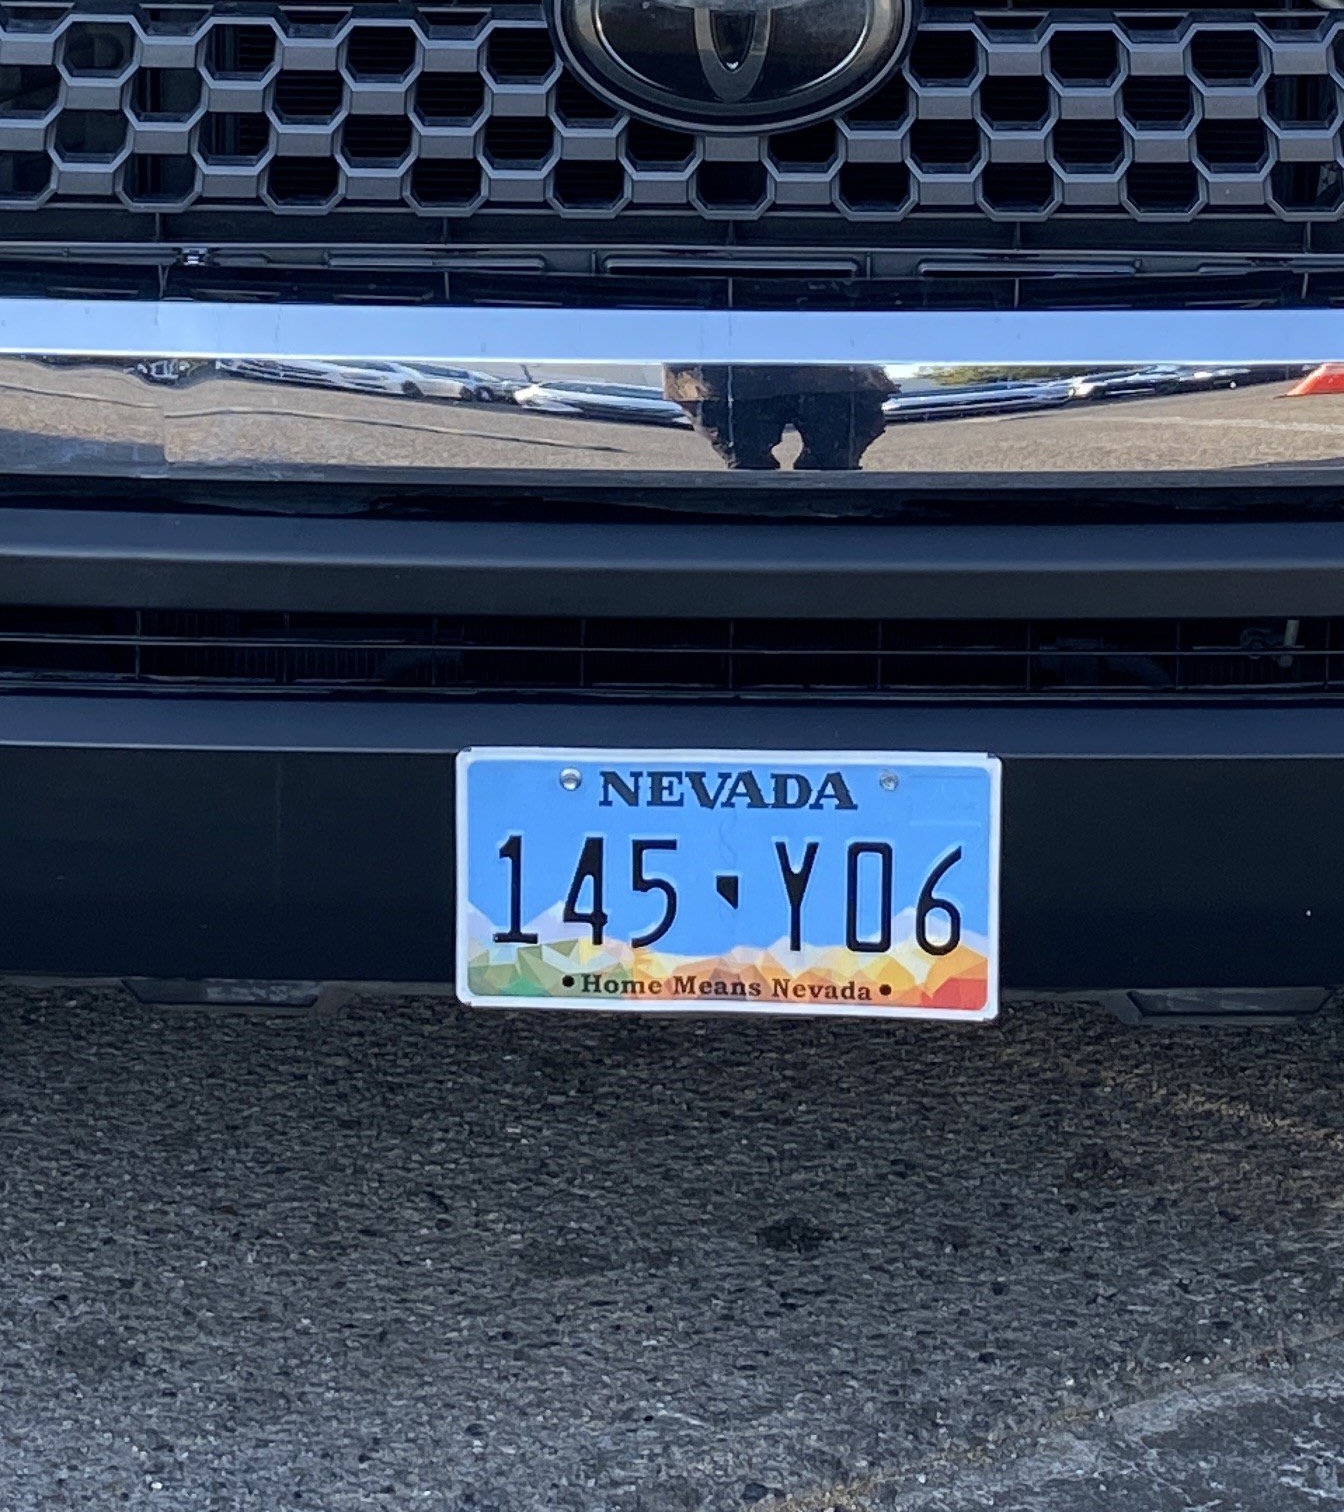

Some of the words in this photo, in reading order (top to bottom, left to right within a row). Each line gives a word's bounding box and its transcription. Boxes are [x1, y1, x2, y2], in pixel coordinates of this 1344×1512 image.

[599, 770, 858, 810] NEVADA
[492, 834, 678, 949] 145
[581, 973, 663, 997] Home
[673, 975, 761, 1001] Means
[772, 978, 874, 1003] Nevada
